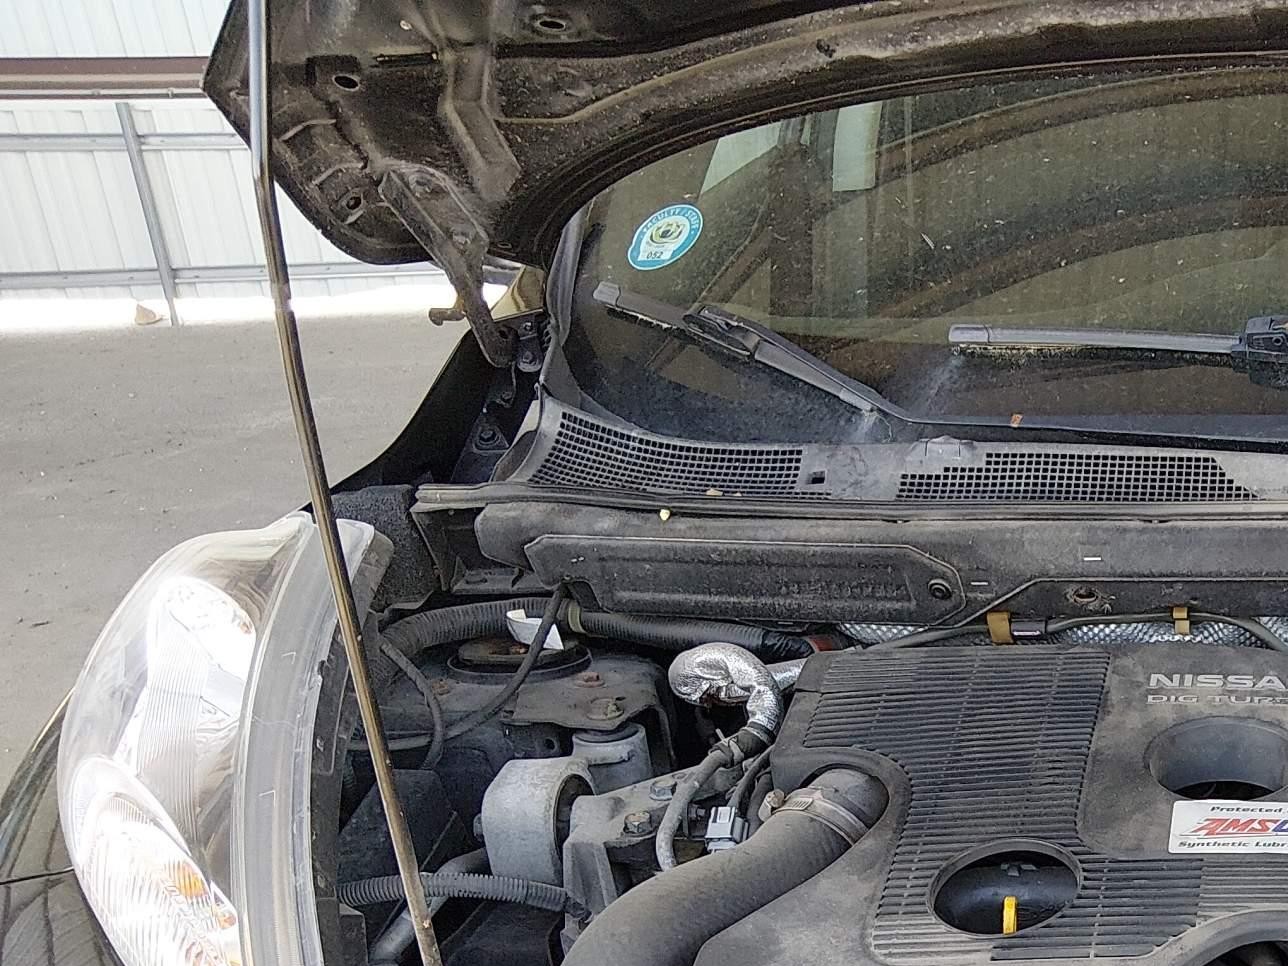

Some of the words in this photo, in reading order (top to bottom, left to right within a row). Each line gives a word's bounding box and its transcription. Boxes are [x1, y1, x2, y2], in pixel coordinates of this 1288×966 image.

[1146, 694, 1199, 705] DIG
[1210, 806, 1283, 815] Protected
[1178, 841, 1250, 850] Synthetic
